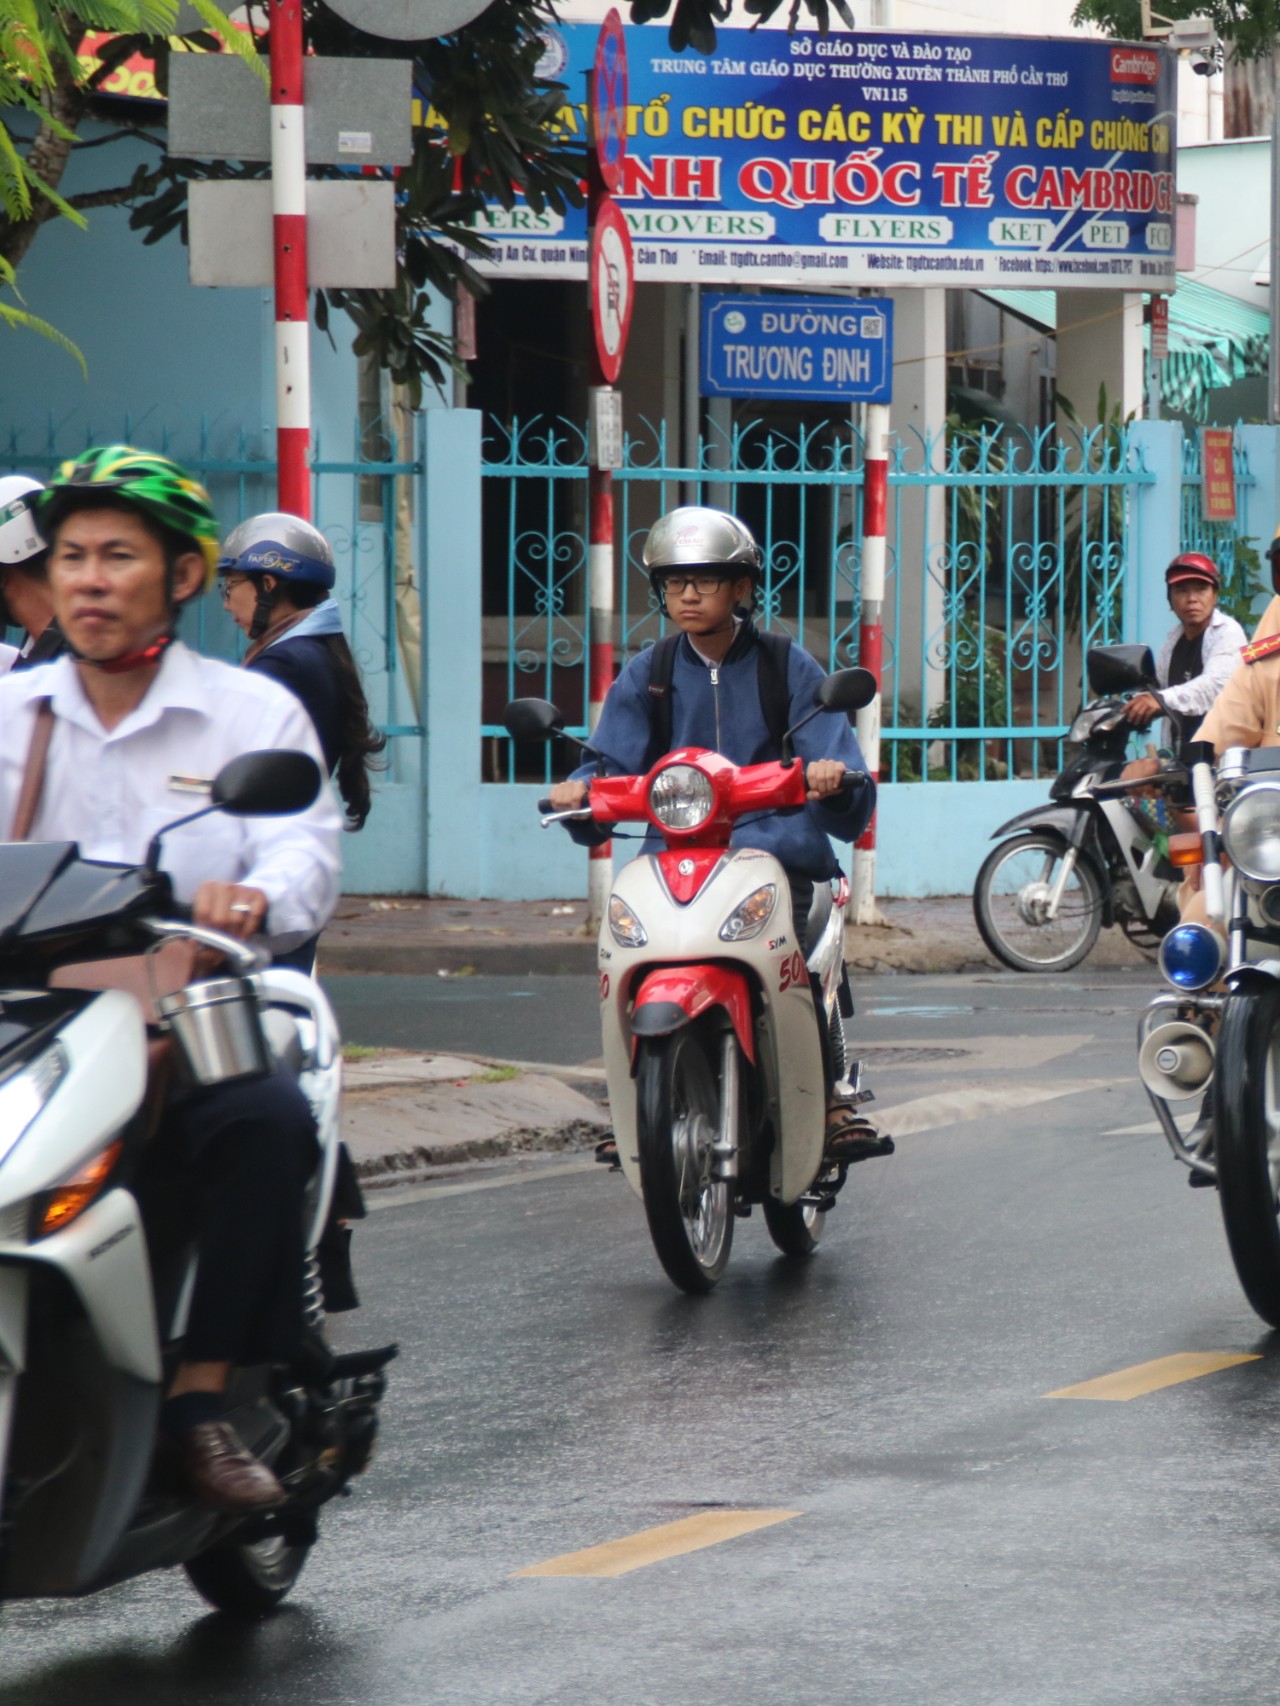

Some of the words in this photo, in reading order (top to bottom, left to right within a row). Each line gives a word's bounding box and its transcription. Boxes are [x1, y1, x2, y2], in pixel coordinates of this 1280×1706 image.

[789, 37, 812, 56] SỞ
[815, 39, 853, 57] GIÁO
[856, 43, 888, 62] DỤC
[890, 41, 911, 59] VÀ
[912, 43, 943, 60] ĐÀO
[945, 46, 972, 65] TẠO
[651, 58, 707, 75] TRUNG
[711, 57, 746, 75] TÂM
[750, 59, 789, 77] GIÁO
[793, 62, 826, 82] DỤC
[829, 61, 893, 80] THƯỜNG
[896, 64, 942, 82] XUYÊN
[946, 65, 991, 83] THÀNH
[993, 64, 1018, 85] PHỐ
[1020, 64, 1043, 86] CẦN
[1046, 71, 1068, 86] THƠ
[1112, 54, 1157, 81] Cambridge
[862, 86, 908, 102] VN115
[626, 93, 670, 137] TỔ
[682, 101, 786, 141] CHỨC
[798, 103, 871, 143] CÁC
[882, 107, 925, 145] KỲ
[935, 114, 983, 146] THI
[992, 110, 1028, 147] VÀ
[1036, 108, 1084, 149] CẤP
[1090, 115, 1149, 152] CHỨNG
[737, 147, 921, 210] QUỐC
[932, 150, 1000, 209] TẾ
[1003, 164, 1174, 214] CAMBRIDGE
[626, 213, 765, 235] MOVERS
[834, 217, 942, 240] FLYERS
[1000, 223, 1047, 242] KET
[1090, 225, 1125, 244] PET
[1150, 228, 1170, 246] FCE
[761, 308, 858, 336] ĐƯỜNG
[723, 345, 813, 382] TRƯƠNG
[821, 347, 871, 389] ĐỊNH
[769, 935, 787, 951] SYM
